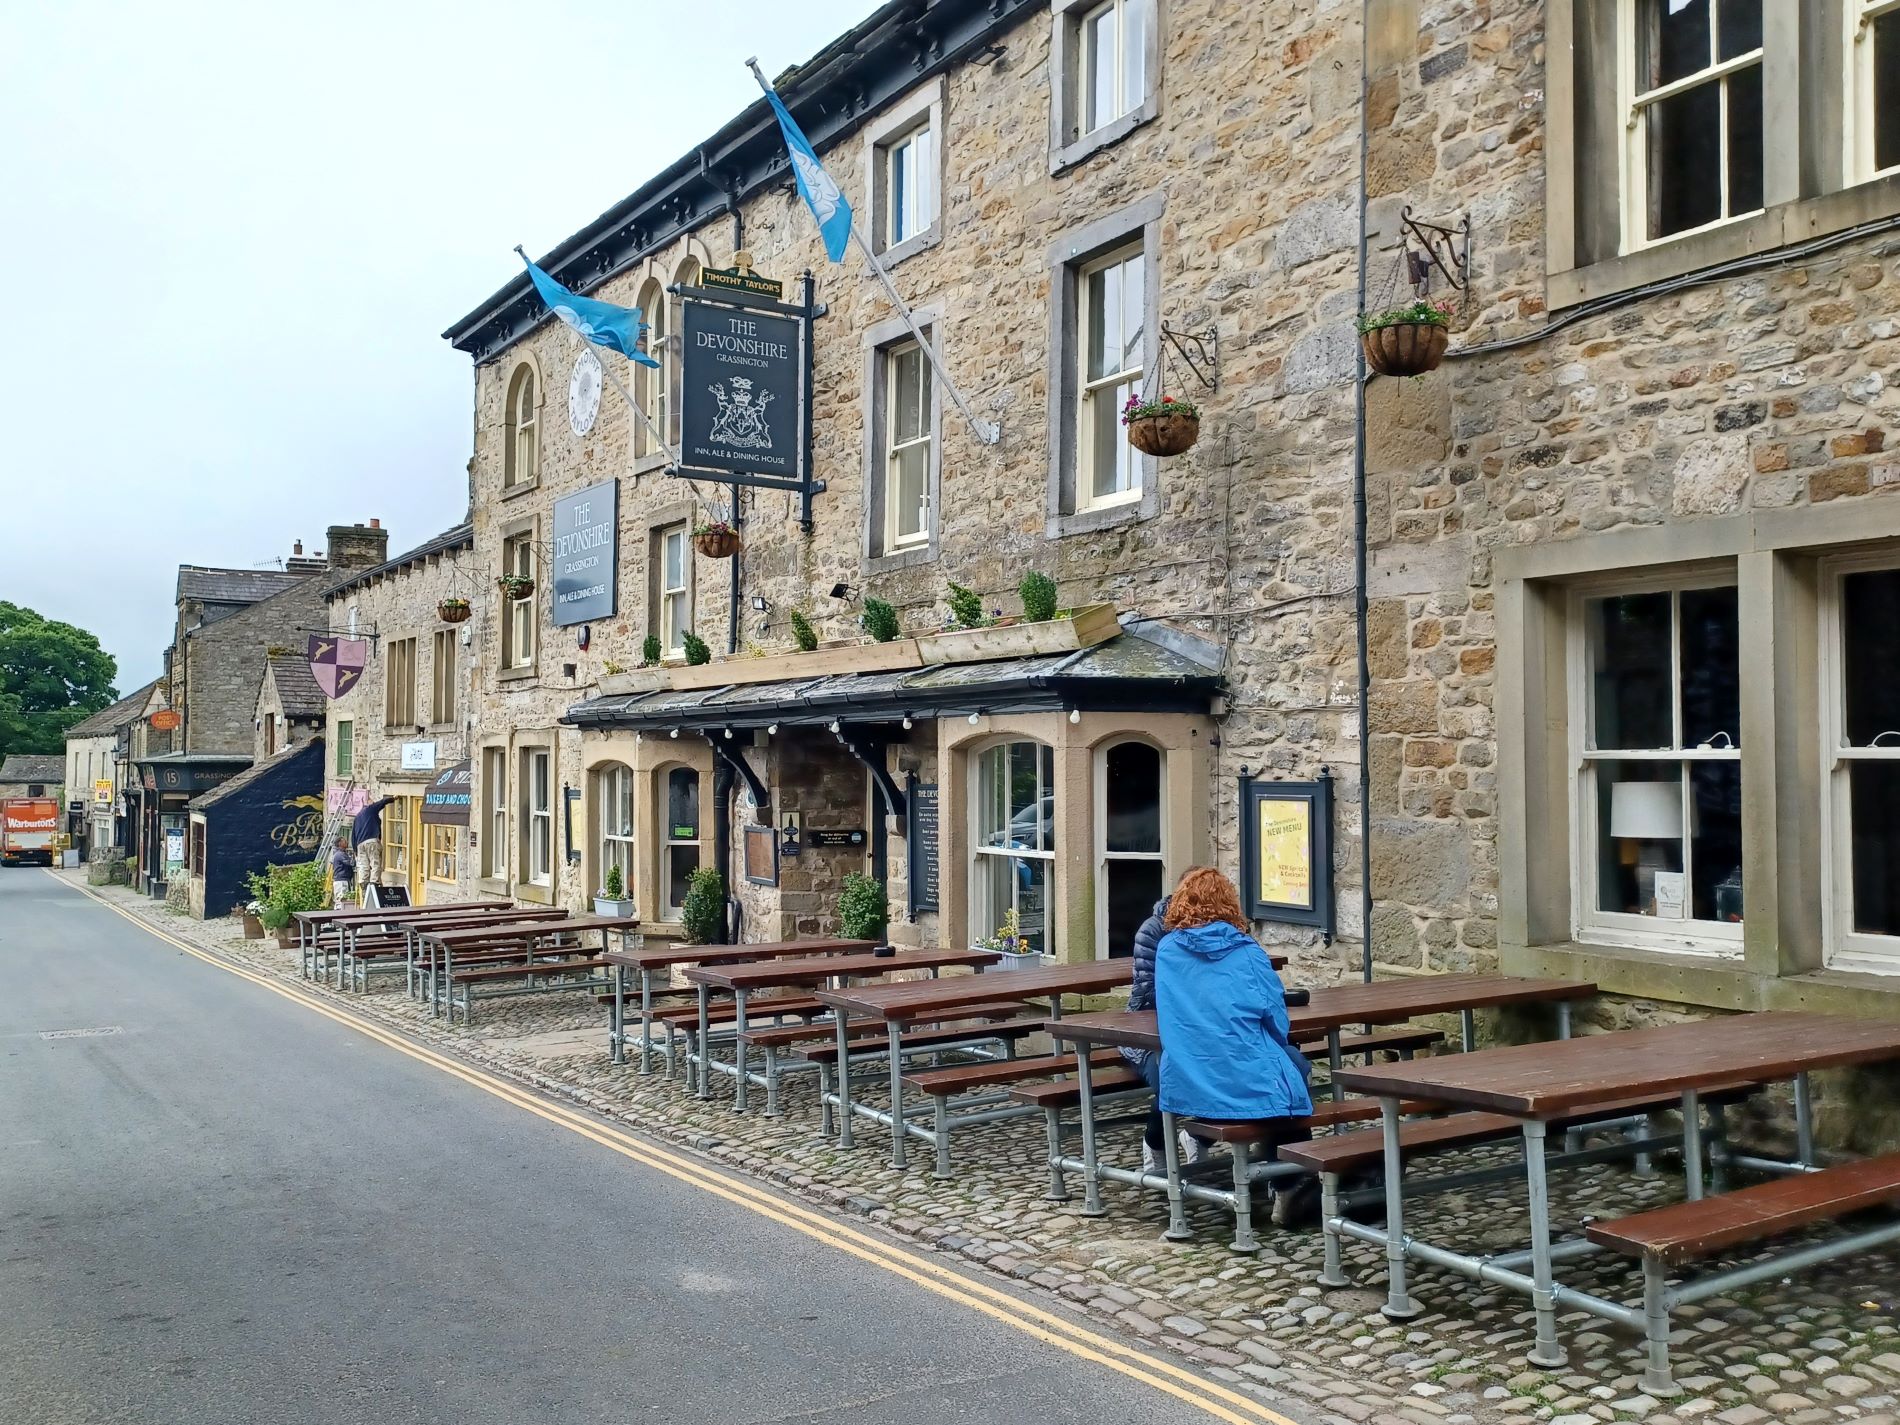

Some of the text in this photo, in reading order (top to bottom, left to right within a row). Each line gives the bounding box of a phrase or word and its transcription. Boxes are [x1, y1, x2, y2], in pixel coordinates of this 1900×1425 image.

[705, 272, 781, 293] TIMOTHY TAYLOR'S
[729, 318, 757, 337] THE
[696, 331, 788, 359] DEVONSHIRE
[573, 352, 600, 382] TIMOTHY
[716, 353, 769, 368] GRASSINGTON
[694, 447, 711, 456] INN,
[711, 449, 725, 458] ALE
[733, 451, 760, 462] DINING
[761, 455, 785, 464] HOUSE
[574, 502, 591, 527] THE
[556, 522, 610, 559] DEVONSHIRE
[564, 555, 599, 574] GRASSINGTON
[576, 587, 591, 600] DINING
[591, 584, 605, 595] HOUSE
[166, 772, 177, 783] 15
[426, 793, 445, 805] BAKERS
[445, 793, 458, 805] AND
[7, 816, 56, 828] Warburtons
[1267, 822, 1302, 837] NEW MENU
